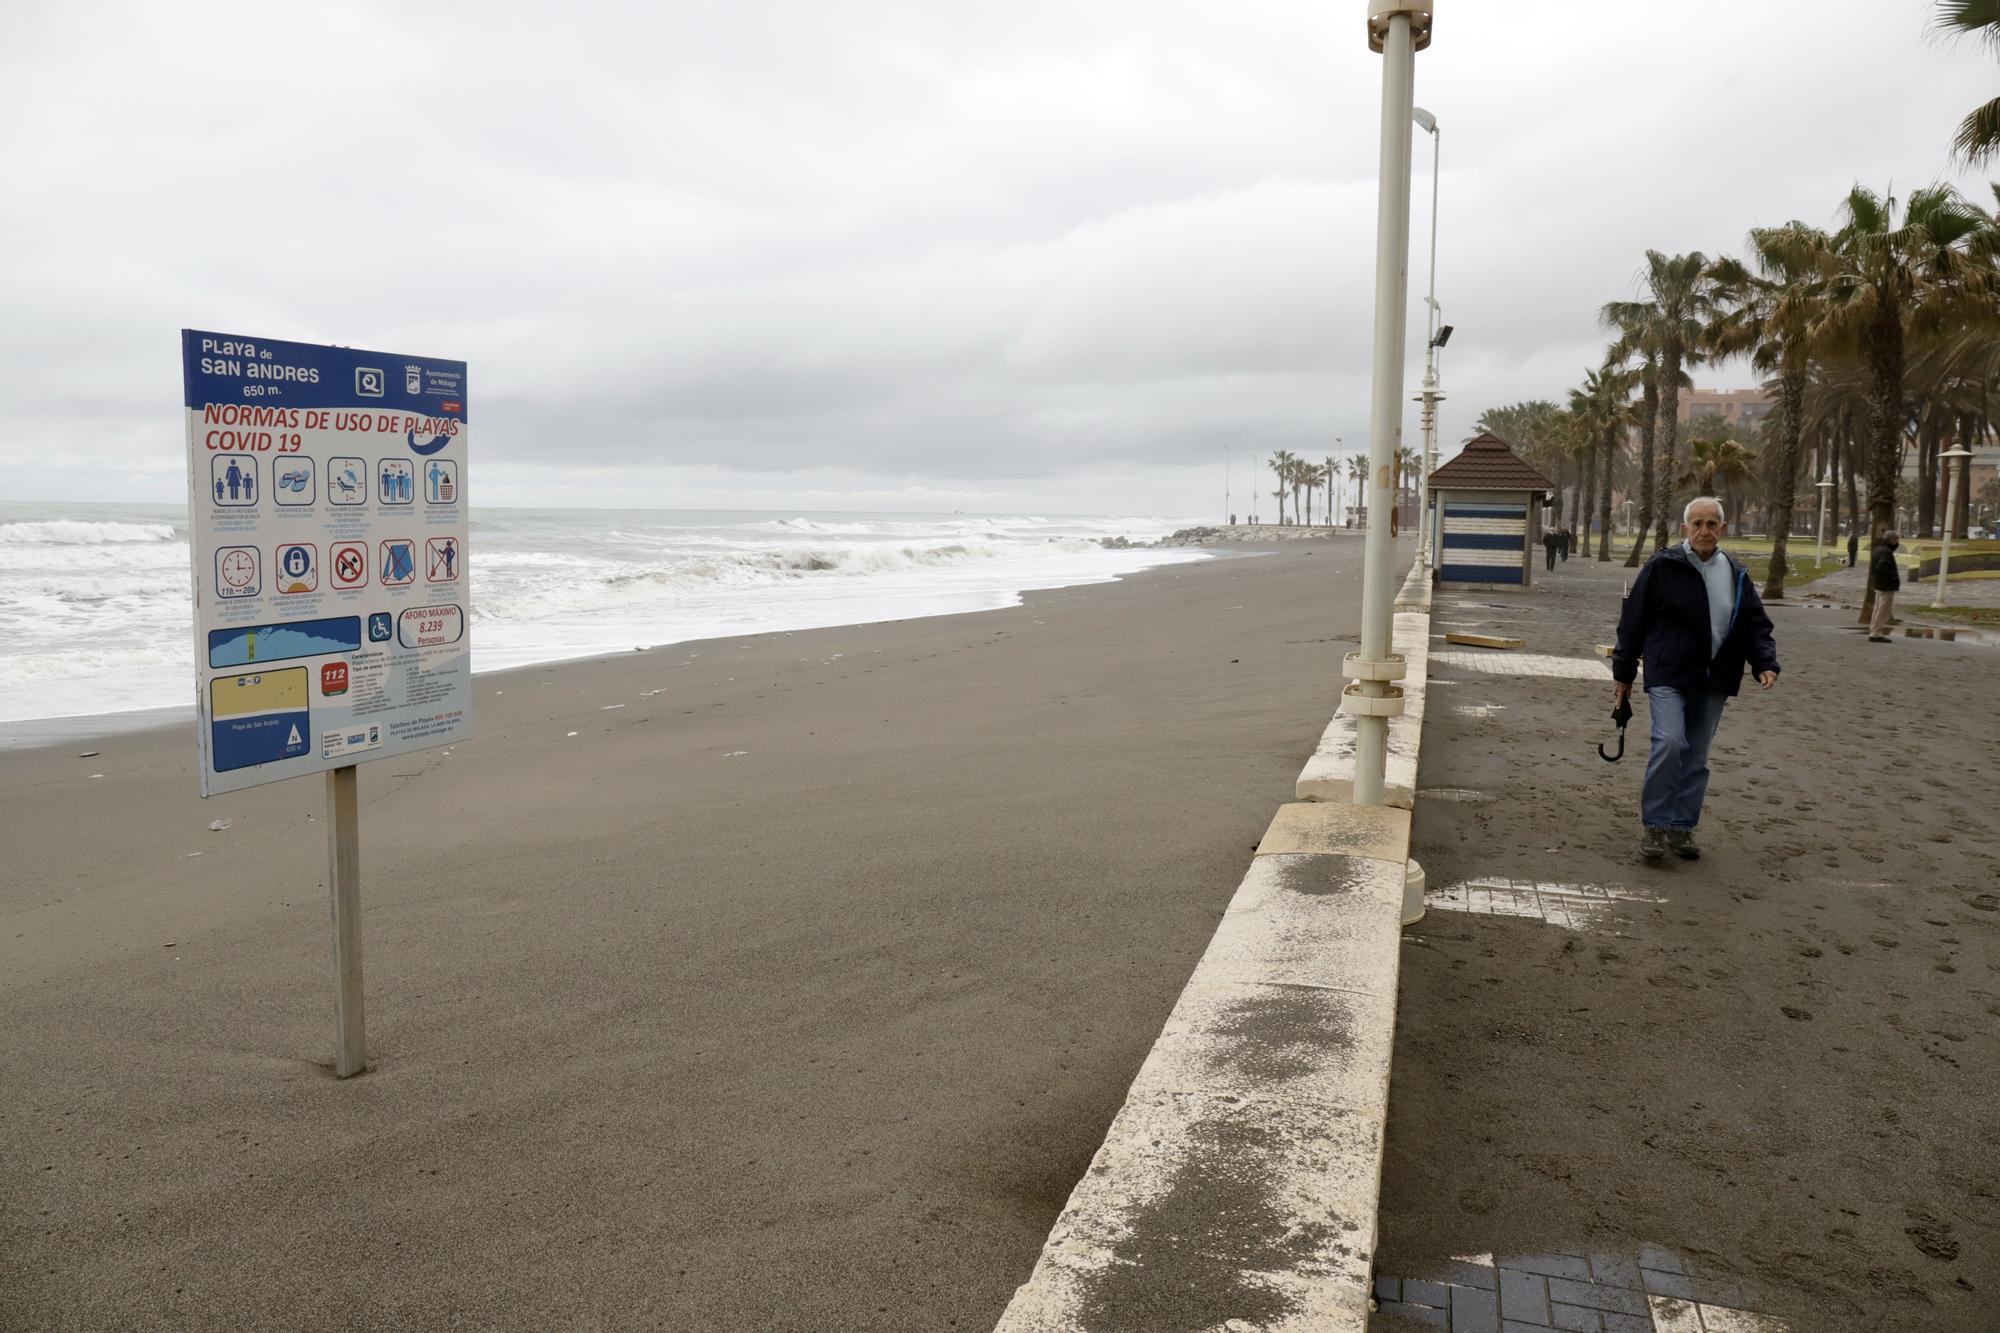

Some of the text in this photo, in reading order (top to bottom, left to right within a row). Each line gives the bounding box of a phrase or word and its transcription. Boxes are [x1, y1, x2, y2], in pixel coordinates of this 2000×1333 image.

[260, 349, 273, 360] de
[243, 385, 282, 397] 650 m.
[204, 404, 460, 436] NORMAS DE USO DE PLAYAS
[205, 430, 302, 453] COVID 19
[405, 610, 428, 621] AFORO
[419, 620, 443, 633] 8.239
[417, 636, 446, 645] Personas
[323, 668, 346, 681] 112
